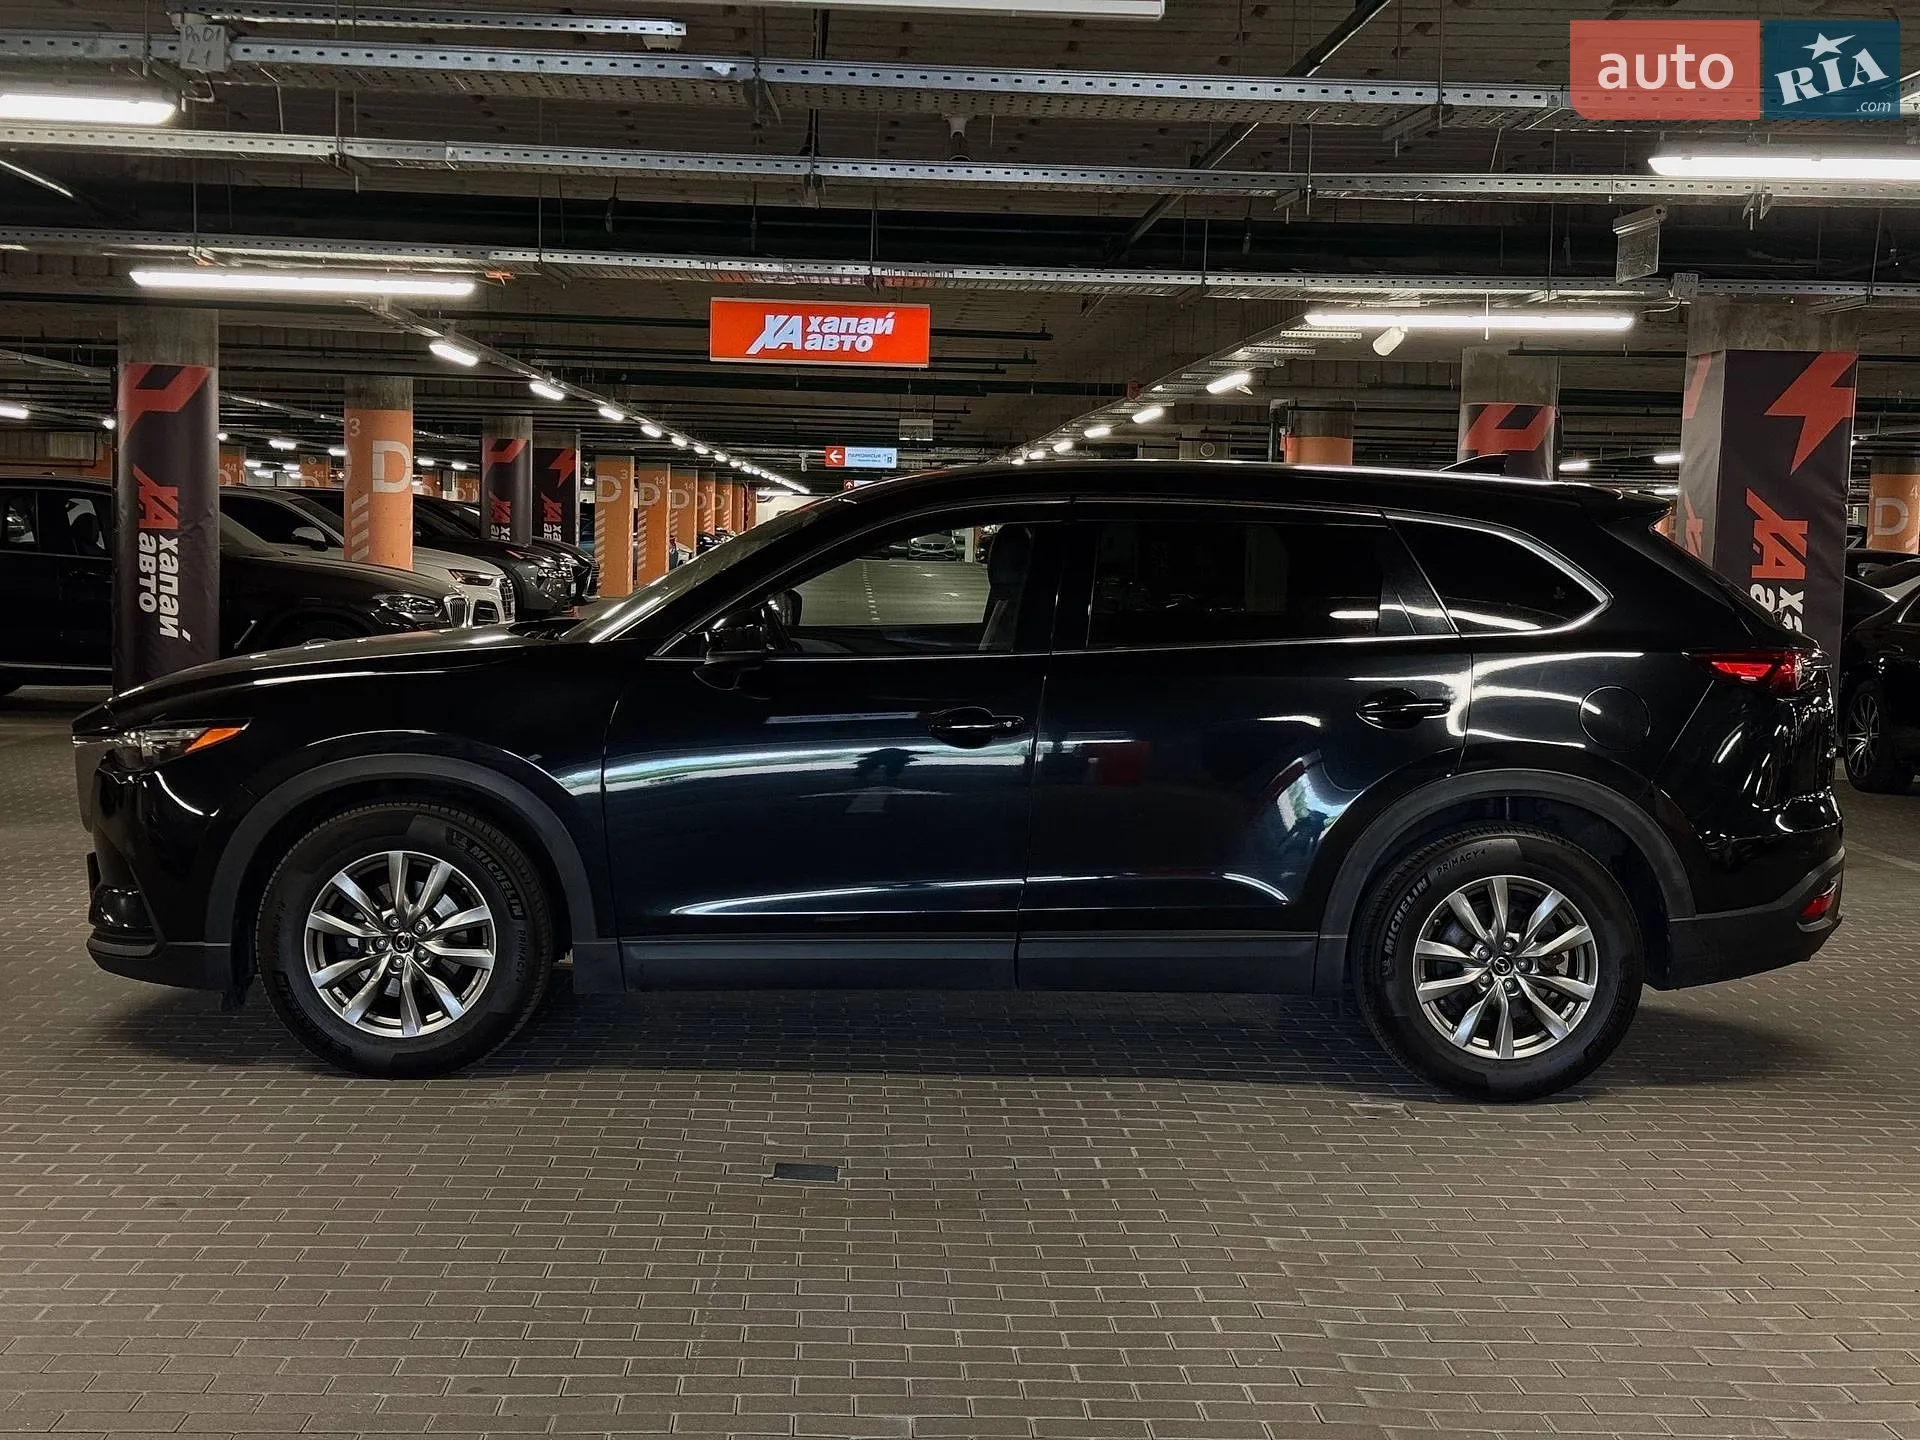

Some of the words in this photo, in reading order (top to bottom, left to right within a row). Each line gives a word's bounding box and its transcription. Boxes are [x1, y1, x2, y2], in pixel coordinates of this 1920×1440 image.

[806, 311, 896, 335] хапай
[804, 335, 873, 352] авто
[349, 418, 360, 437] 3
[225, 463, 237, 474] 14
[372, 440, 413, 493] D
[597, 475, 622, 502] D
[620, 469, 629, 480] 3
[639, 482, 661, 506] D
[671, 488, 690, 509] D
[683, 482, 695, 490] 14
[1874, 497, 1909, 536] D
[138, 531, 158, 614] авто
[159, 534, 191, 642] хапай
[469, 845, 525, 917] MICHELIN
[1383, 878, 1428, 955] MICHELIN
[1436, 850, 1480, 876] PRIMACY
